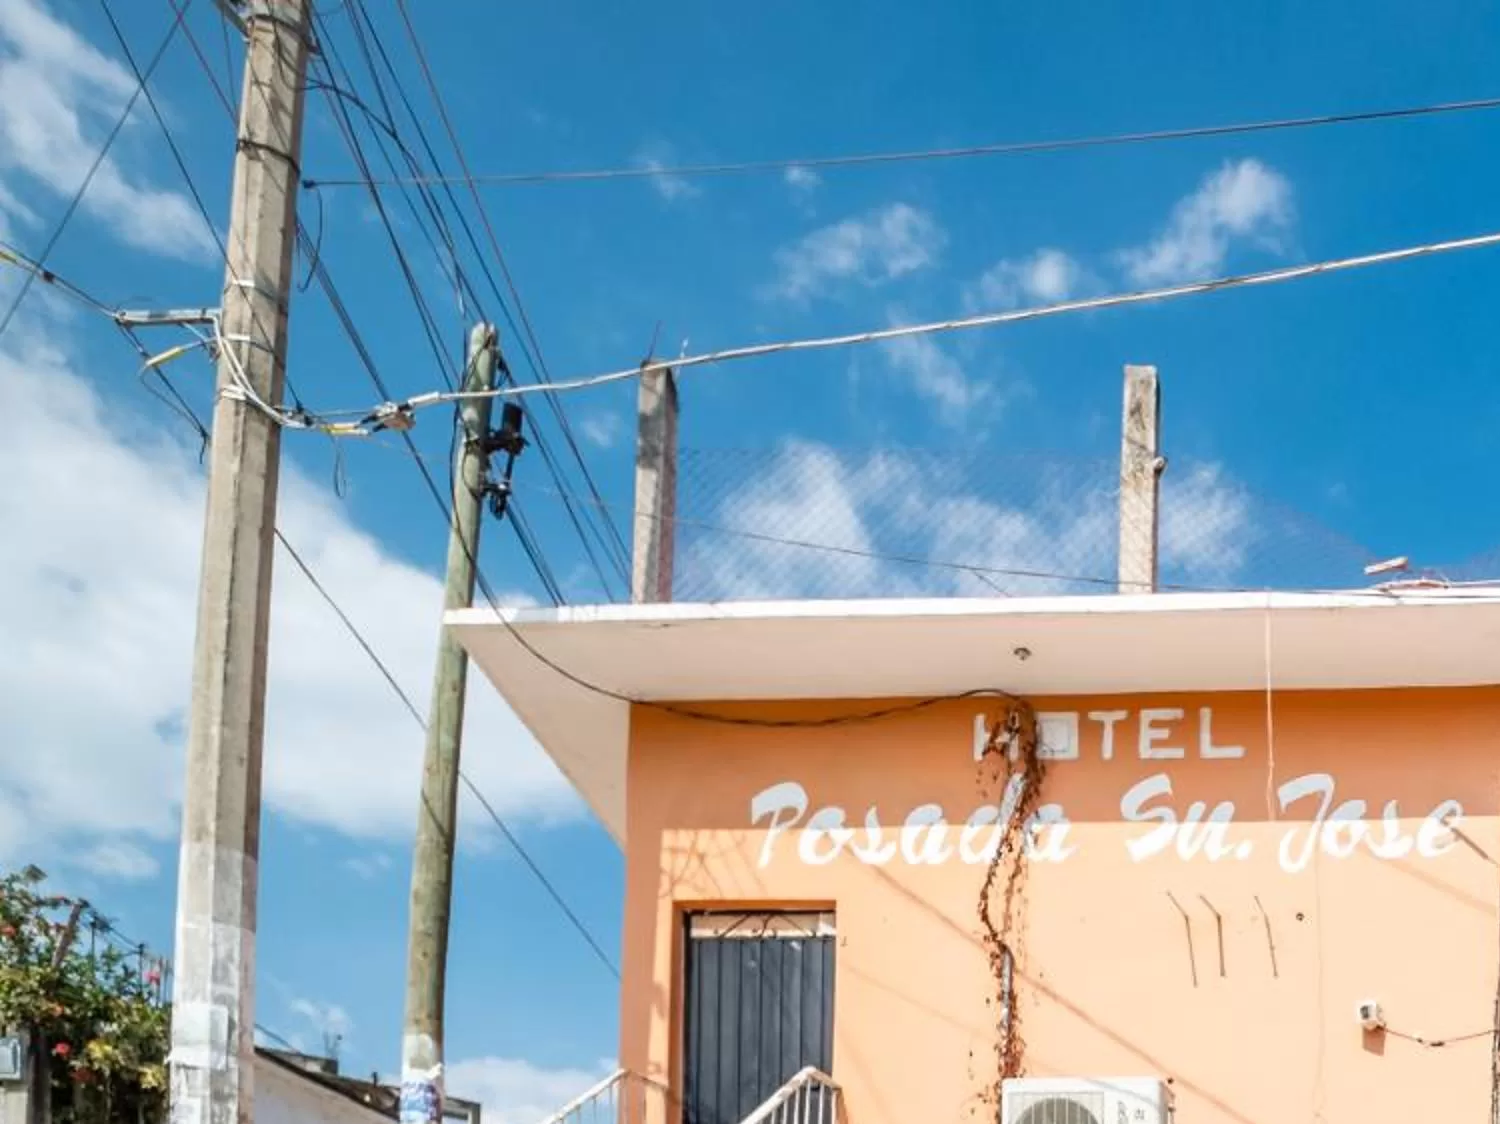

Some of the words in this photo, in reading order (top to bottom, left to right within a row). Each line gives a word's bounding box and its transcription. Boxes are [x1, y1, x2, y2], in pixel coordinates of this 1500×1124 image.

[973, 707, 1246, 761] HOTEL
[751, 782, 1077, 868] Posada
[1277, 773, 1466, 873] Jose
